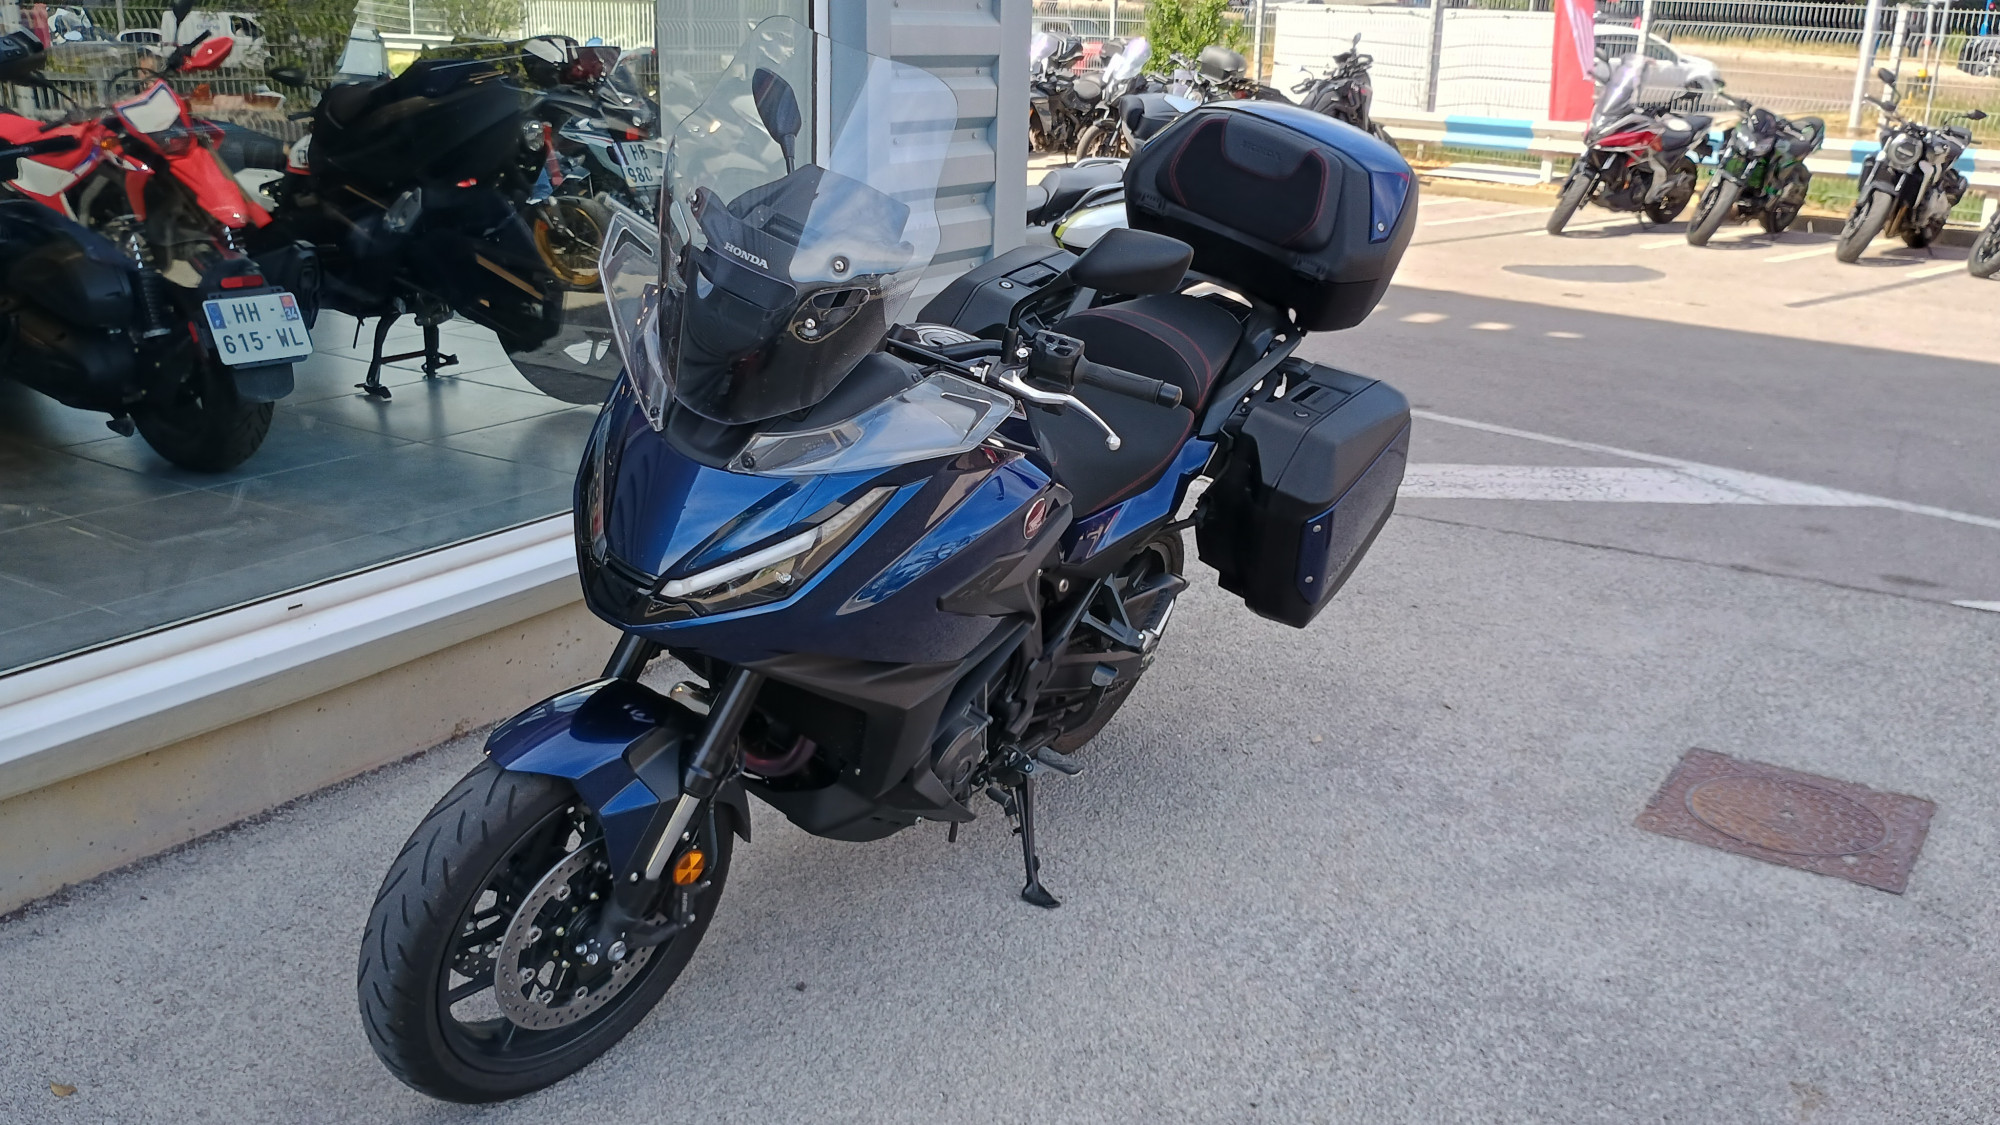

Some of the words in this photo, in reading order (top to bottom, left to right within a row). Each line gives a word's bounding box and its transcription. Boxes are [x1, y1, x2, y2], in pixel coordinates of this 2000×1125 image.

[723, 241, 769, 270] HONDA
[284, 306, 298, 320] 34
[222, 327, 304, 354] 615-WL
